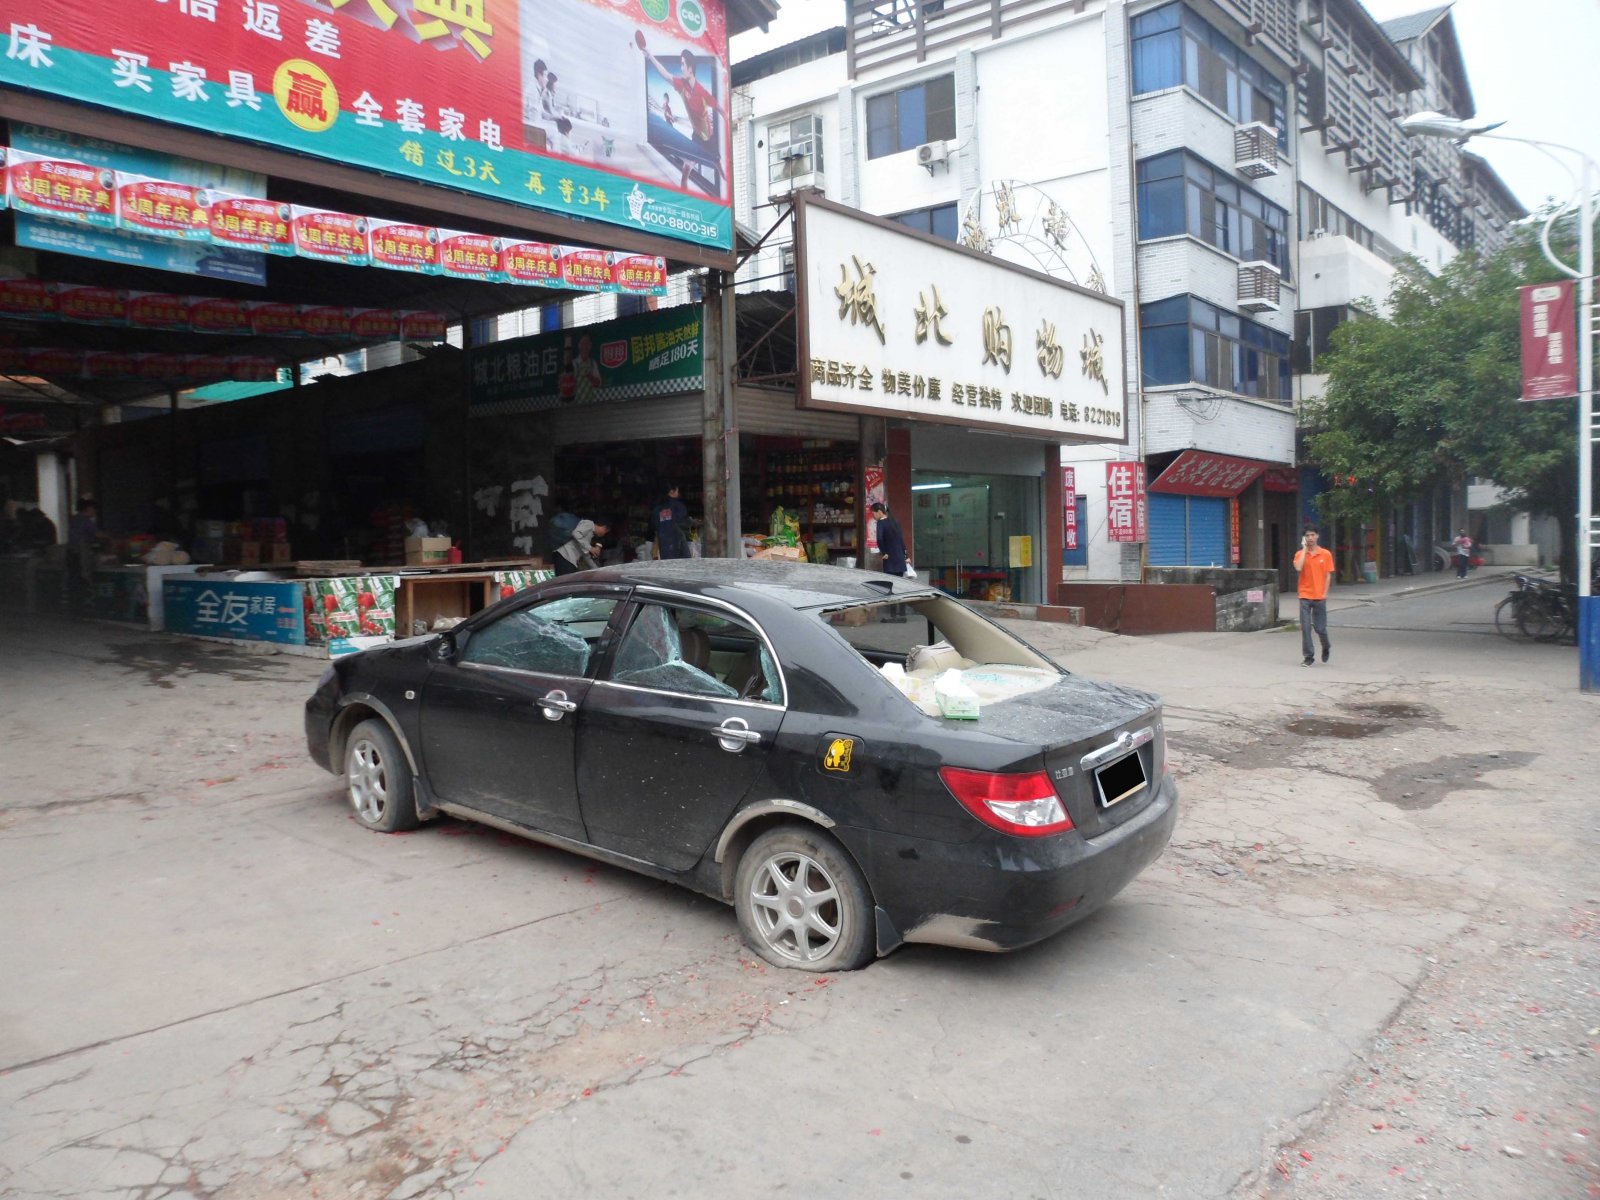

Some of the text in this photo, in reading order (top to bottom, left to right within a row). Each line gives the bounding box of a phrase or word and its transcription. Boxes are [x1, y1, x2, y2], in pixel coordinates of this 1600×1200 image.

[7, 23, 504, 153] 床 买家具 赢 全套家电
[399, 140, 610, 212] 错过3天 再等3年
[833, 254, 1109, 395] 城北购物城
[473, 347, 558, 386] 城北粮油店
[809, 358, 873, 391] 商品齐全
[881, 368, 942, 401] 物美价廉
[951, 381, 1003, 412] 经营独特
[1010, 391, 1054, 420] 欢迎团购
[1064, 471, 1077, 547] 废旧回收
[1108, 466, 1133, 528] 住宿
[195, 589, 277, 626] 全友家居
